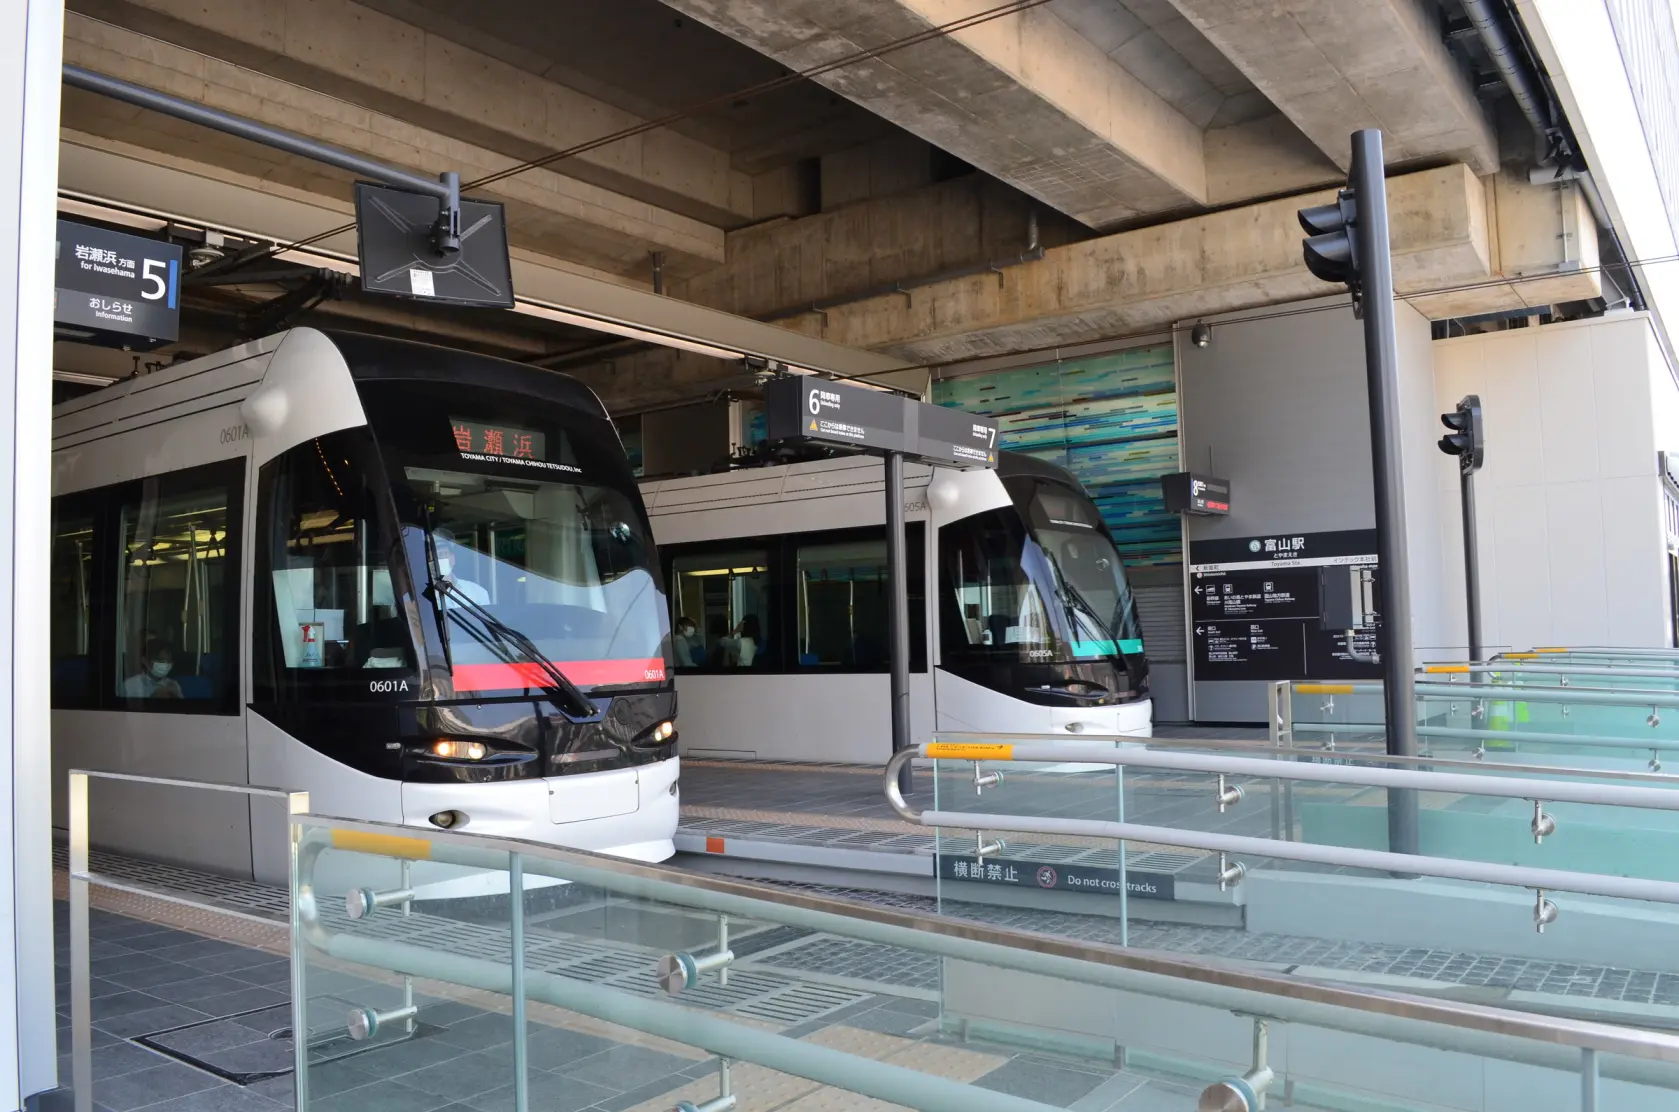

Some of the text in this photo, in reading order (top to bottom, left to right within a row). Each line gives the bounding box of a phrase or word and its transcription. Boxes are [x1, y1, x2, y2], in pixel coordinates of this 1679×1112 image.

[75, 244, 136, 269] 岩瀬浜 方面
[80, 261, 135, 279] for Iwasehama
[141, 258, 166, 300] 5
[89, 297, 133, 315] おしらせ
[95, 311, 133, 322] Information
[808, 388, 820, 415] 6
[220, 424, 249, 445] 0601A
[452, 424, 534, 459] 岩瀬浜
[988, 427, 996, 449] 7
[460, 452, 485, 462] TOYAMA
[485, 455, 499, 463] CITY
[502, 457, 525, 466] TOYAMA
[1193, 479, 1199, 496] 8
[1264, 537, 1305, 552] 富山駅
[1029, 650, 1053, 658] 0605A
[644, 669, 665, 679] 0601A
[369, 680, 409, 692] 0601A
[953, 860, 1019, 882] 横断禁止
[1067, 875, 1157, 893] Do not cros tracks
